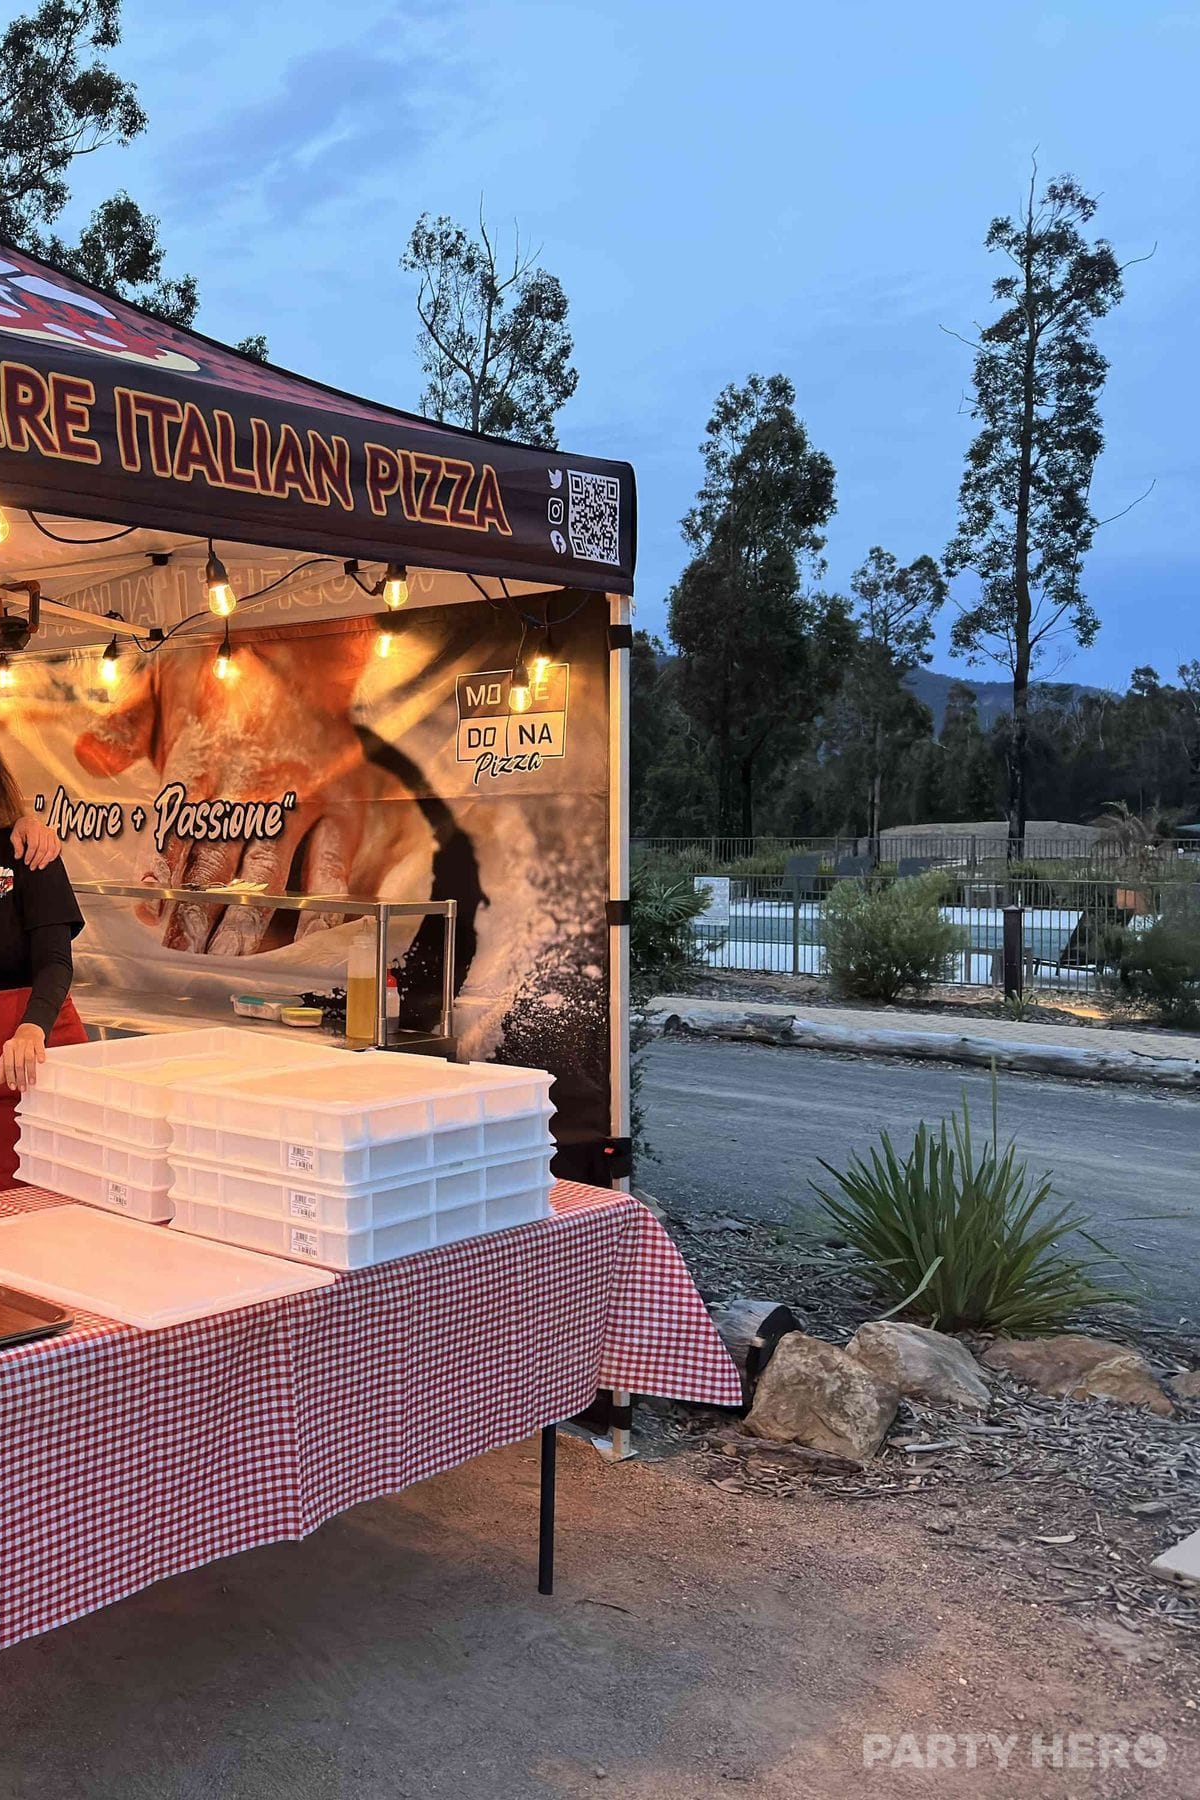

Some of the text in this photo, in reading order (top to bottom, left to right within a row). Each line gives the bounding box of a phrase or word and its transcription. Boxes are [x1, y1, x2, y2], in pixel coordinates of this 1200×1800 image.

[114, 386, 355, 511] ITALIAN
[365, 442, 513, 537] PIZZA
[473, 751, 542, 785] Pizza
